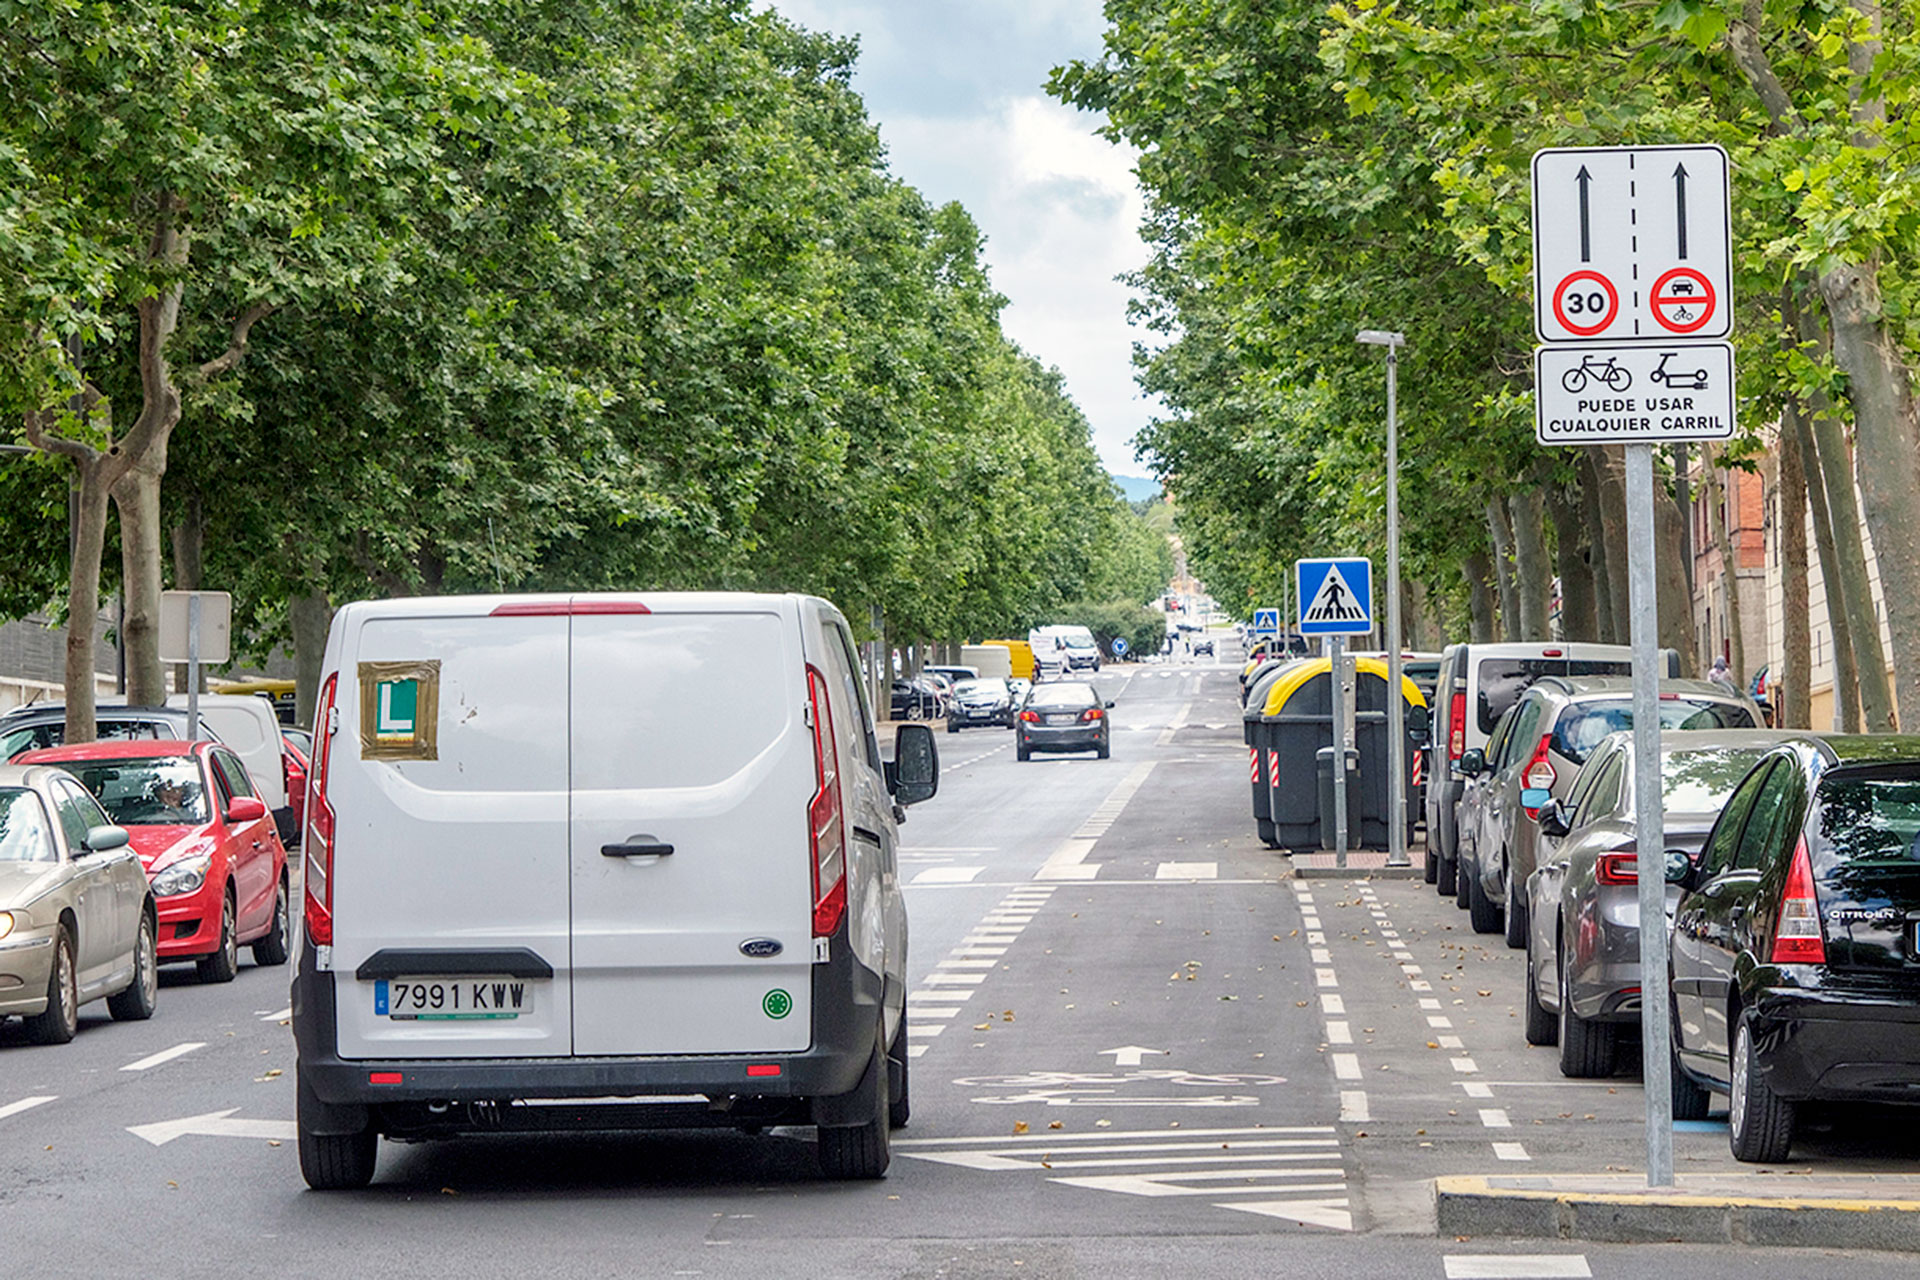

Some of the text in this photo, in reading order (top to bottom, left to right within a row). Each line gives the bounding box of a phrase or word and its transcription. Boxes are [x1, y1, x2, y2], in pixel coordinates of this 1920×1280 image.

[1567, 292, 1605, 314] 30
[1578, 397, 1694, 413] PUEDE USAR
[1549, 415, 1724, 433] CUALQUIER CARRIL
[380, 683, 412, 729] L
[394, 983, 524, 1009] 7991 KWW
